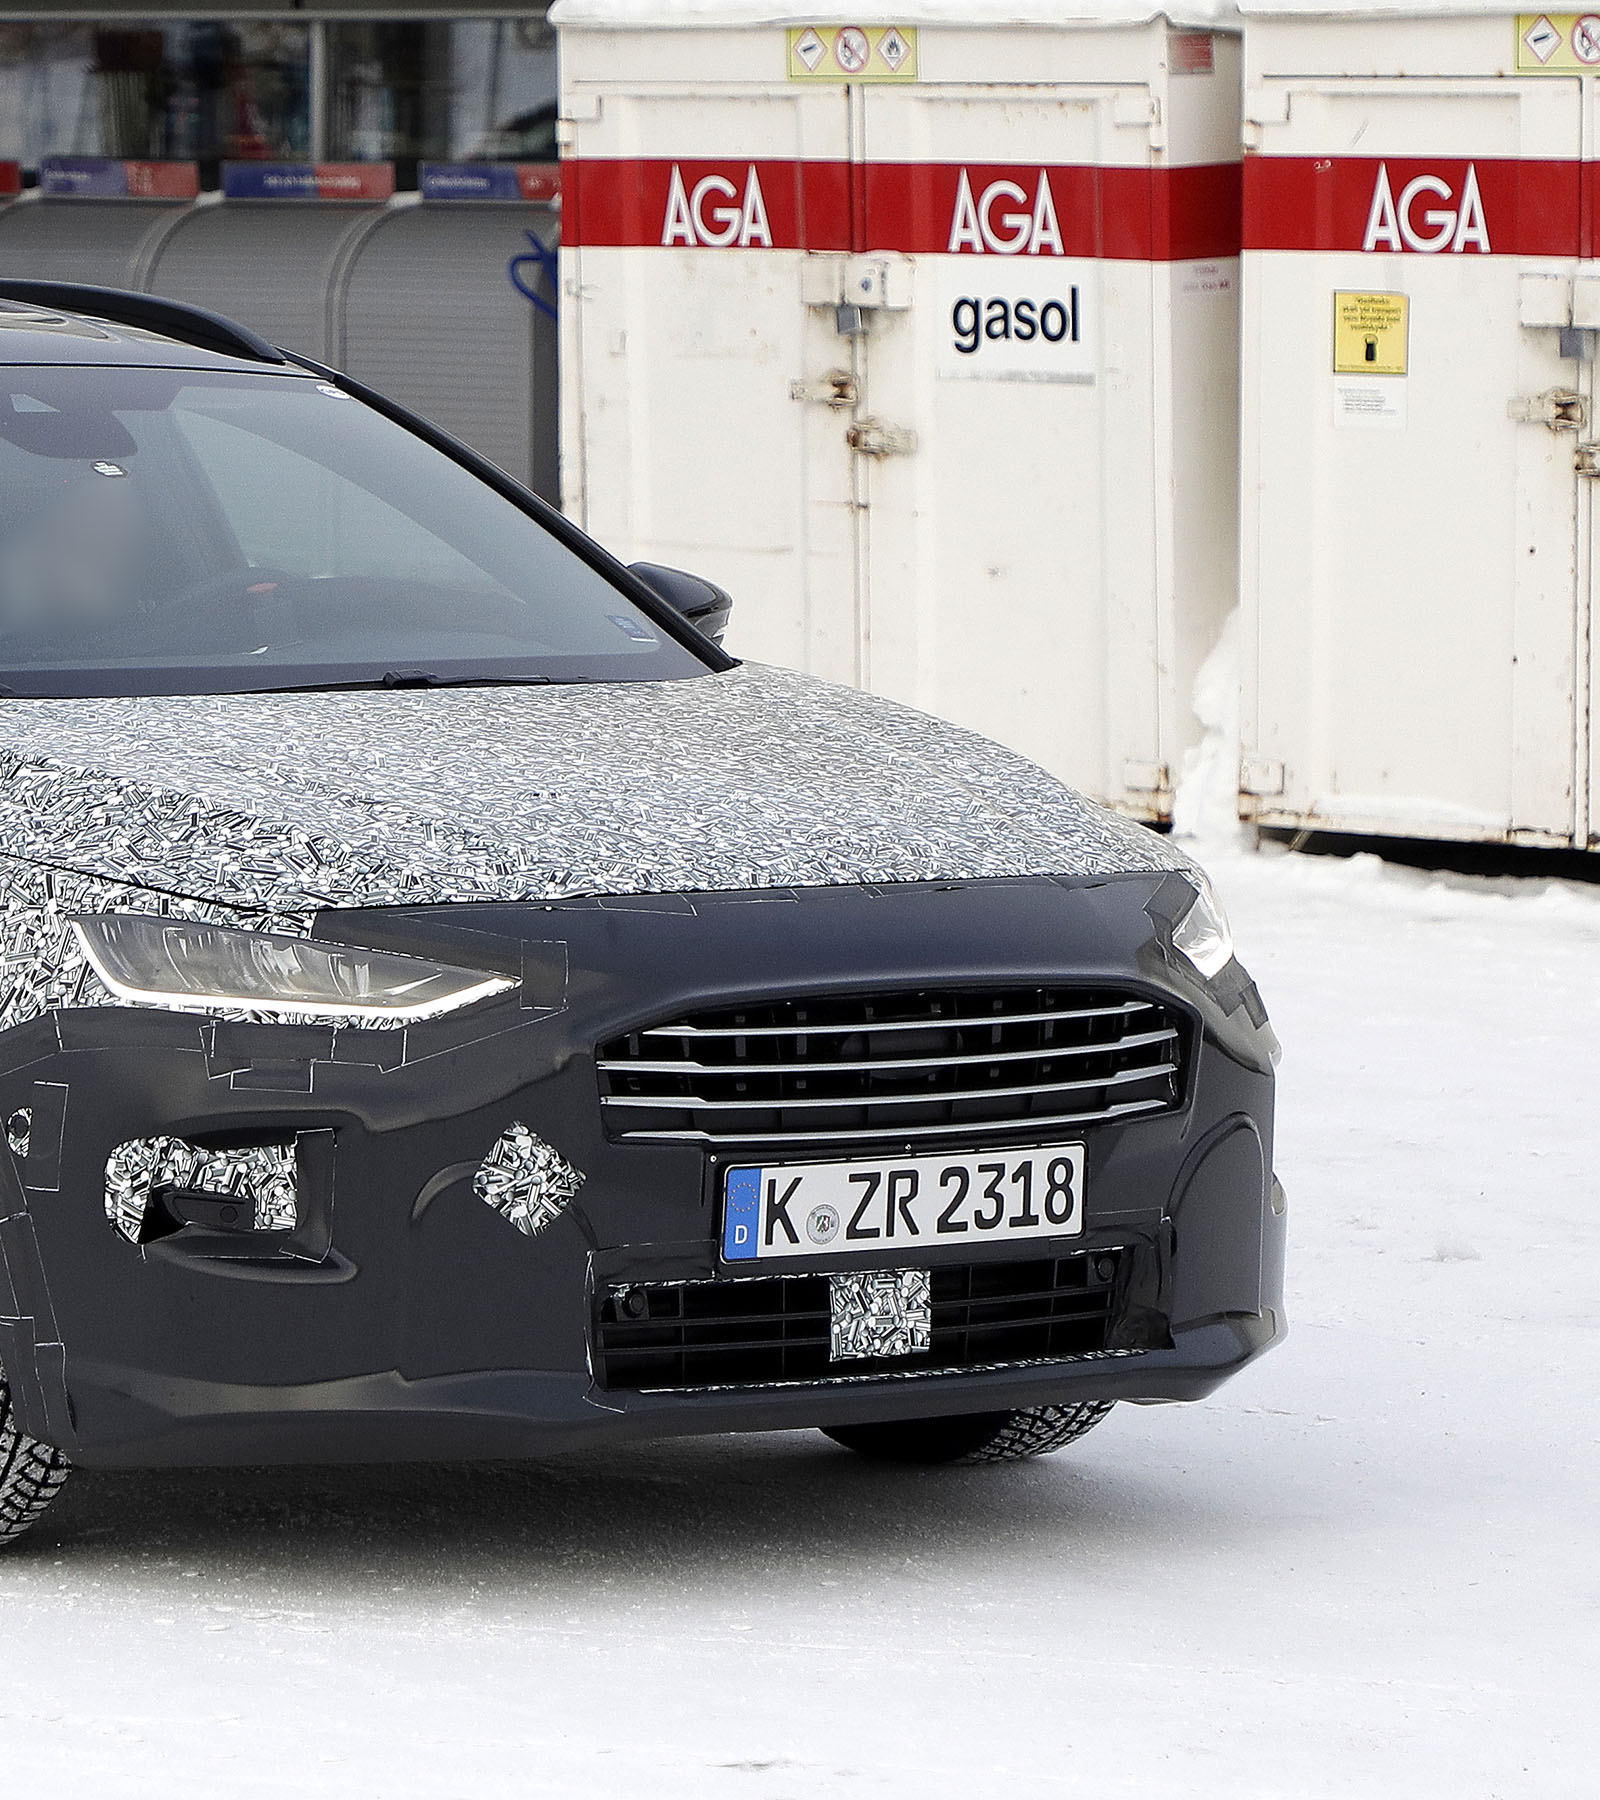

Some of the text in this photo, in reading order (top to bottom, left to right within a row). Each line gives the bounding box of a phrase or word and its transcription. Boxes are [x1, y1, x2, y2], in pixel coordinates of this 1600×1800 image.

[661, 163, 773, 247] AGA
[948, 167, 1065, 255] AGA
[1362, 161, 1491, 253] AGA
[952, 284, 1080, 354] gasol
[734, 1224, 749, 1244] D
[764, 1177, 803, 1246] K
[846, 1169, 919, 1240] ZR
[937, 1157, 1075, 1234] 2318
